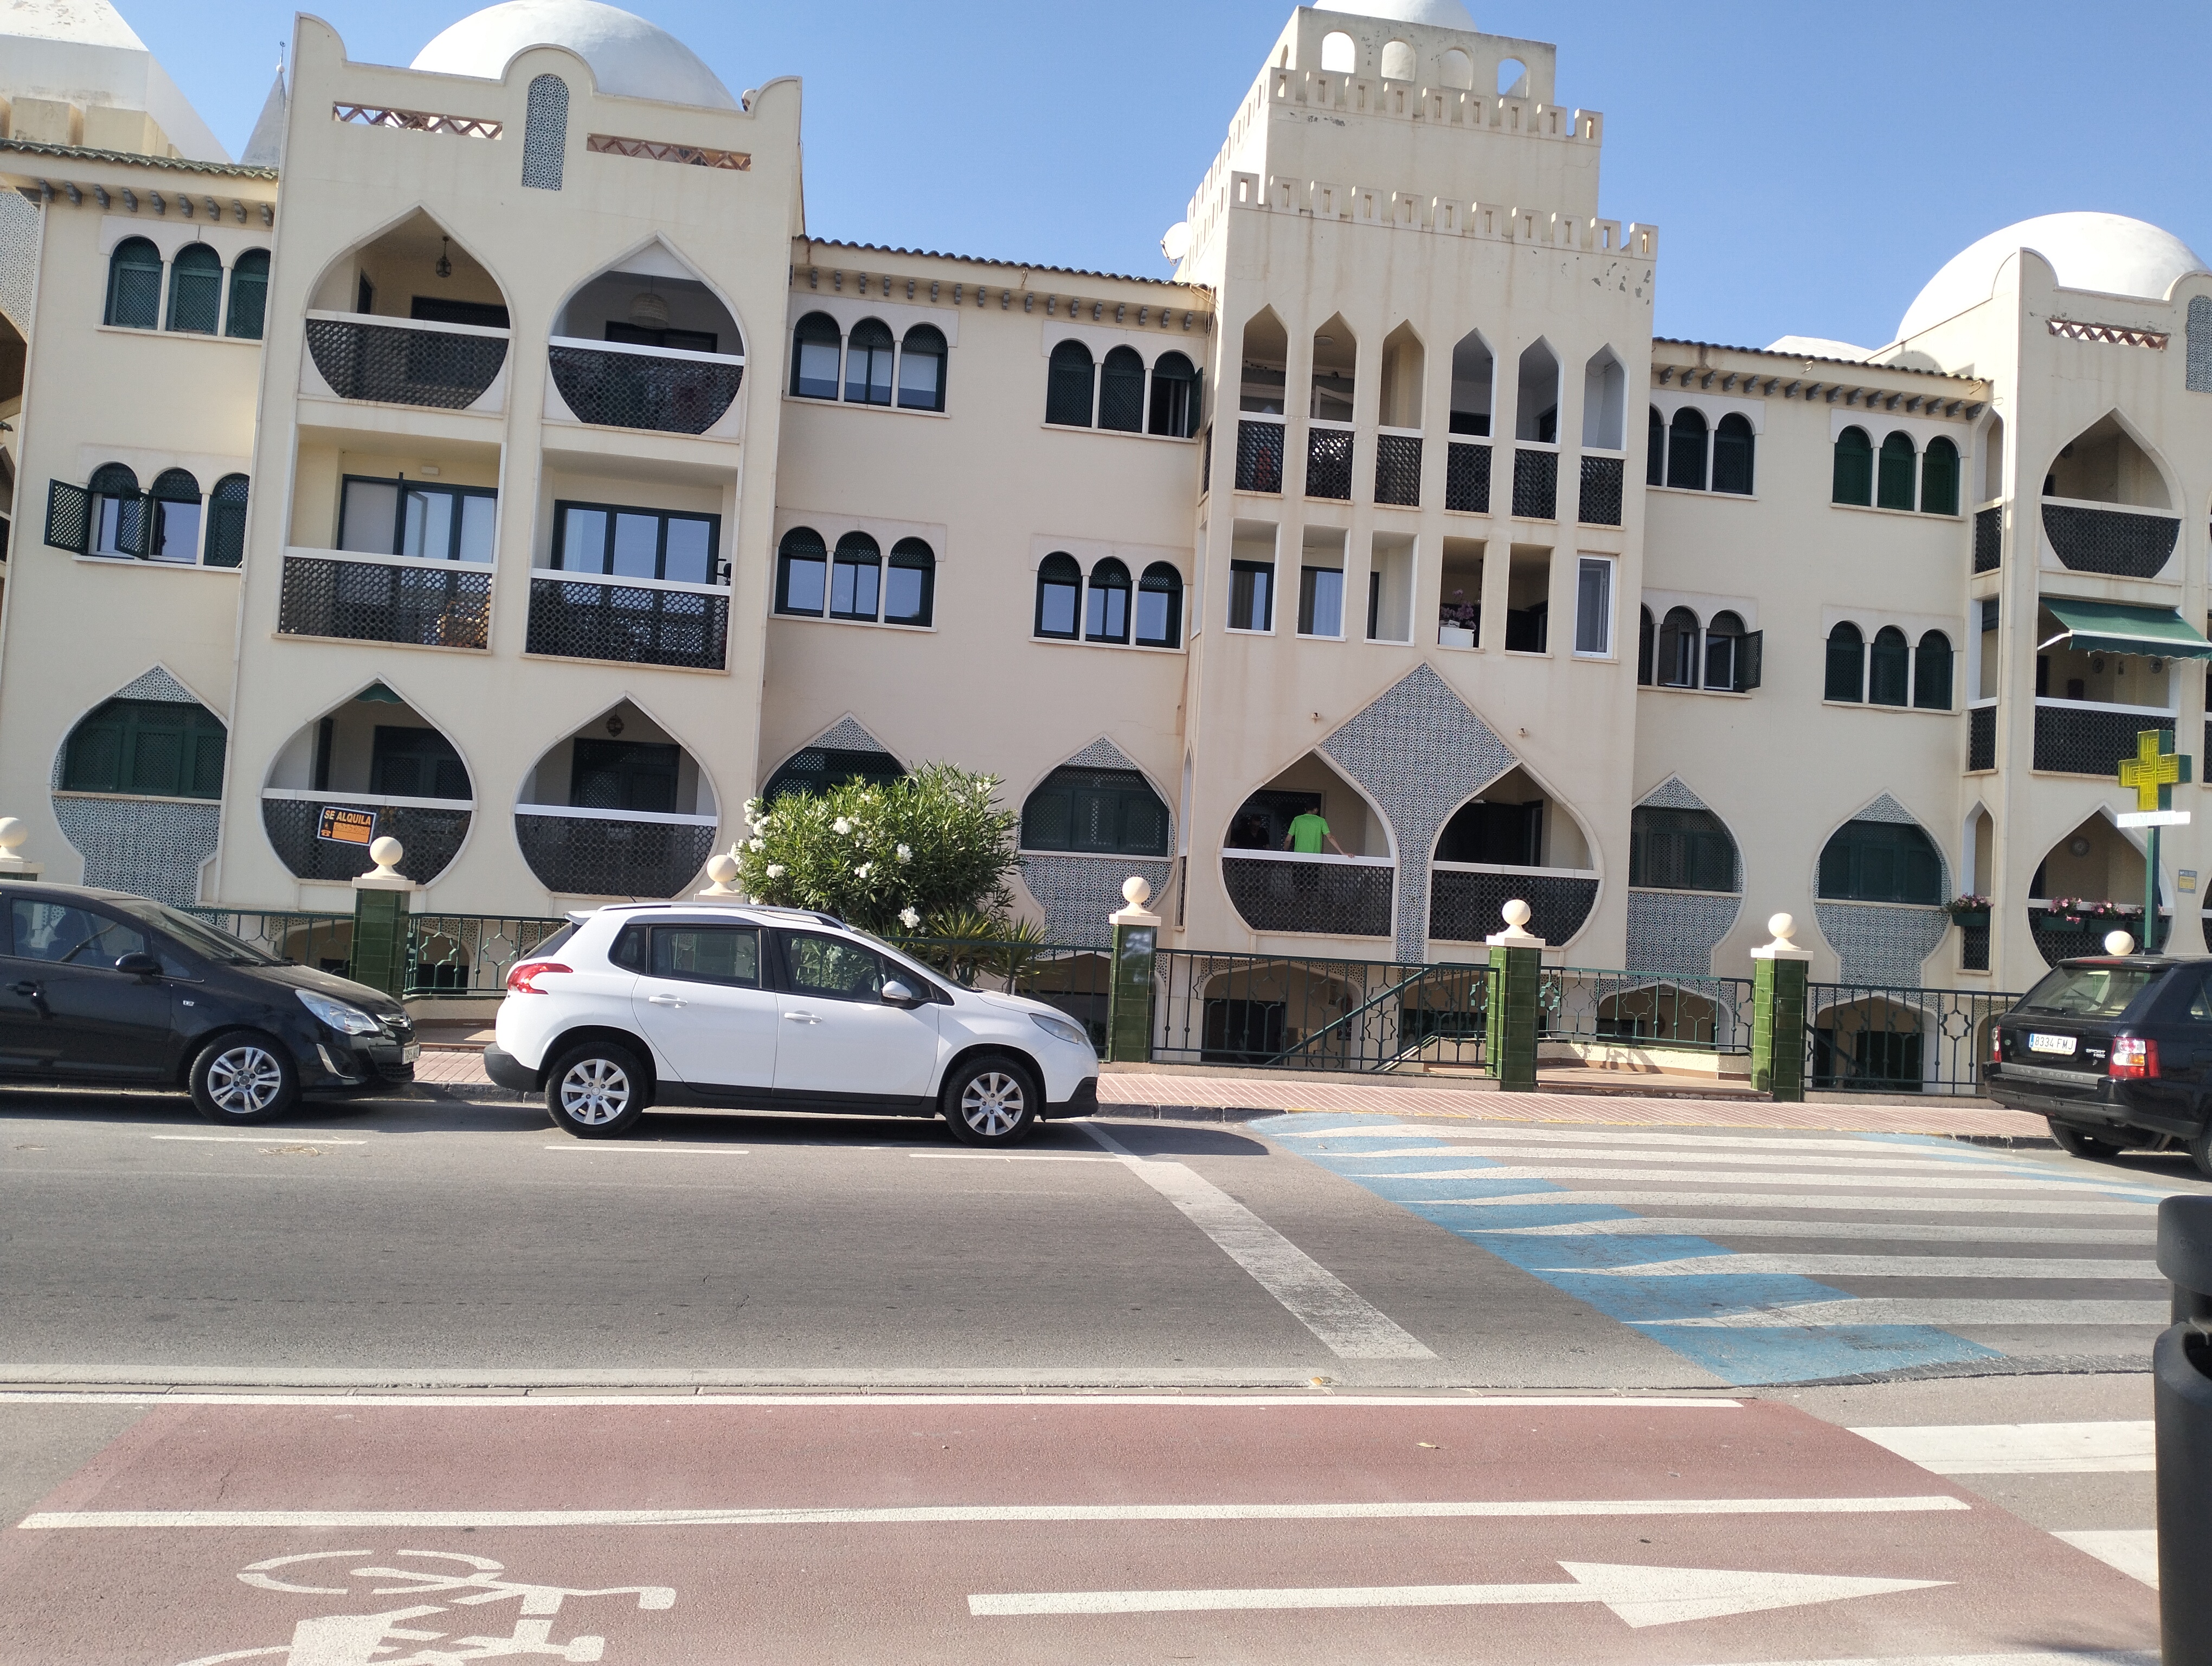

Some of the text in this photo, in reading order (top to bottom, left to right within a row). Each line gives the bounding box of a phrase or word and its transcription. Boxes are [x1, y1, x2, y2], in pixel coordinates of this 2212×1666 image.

[324, 810, 371, 825] SE ALQUILA
[2120, 812, 2172, 826] FARMACIA
[2035, 1036, 2074, 1050] 8334 FMJ
